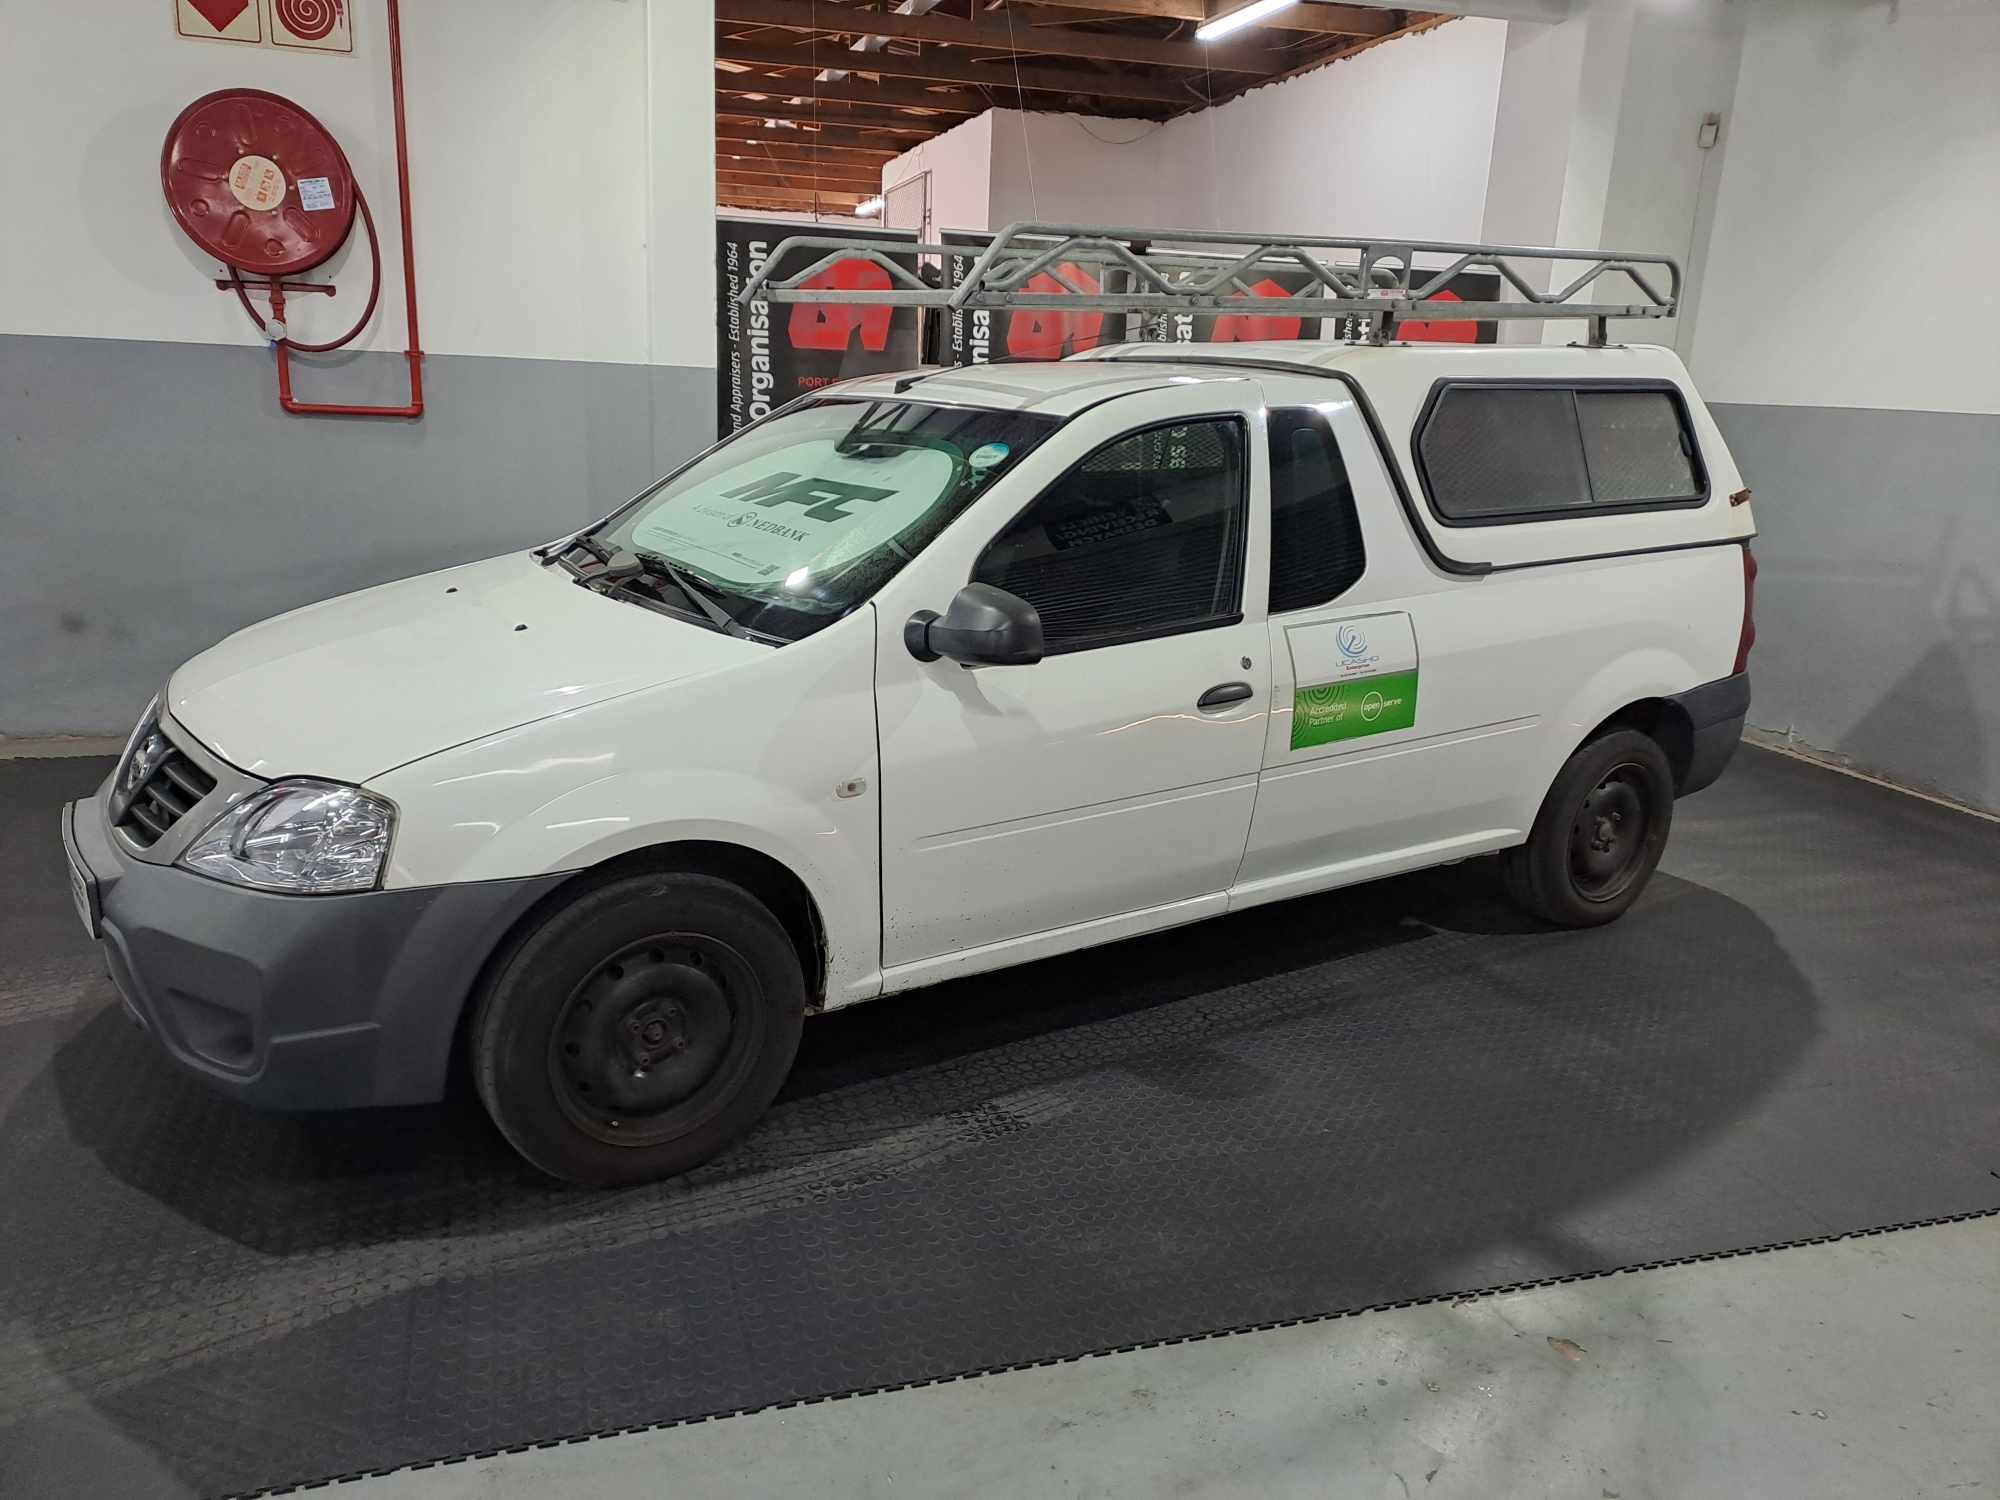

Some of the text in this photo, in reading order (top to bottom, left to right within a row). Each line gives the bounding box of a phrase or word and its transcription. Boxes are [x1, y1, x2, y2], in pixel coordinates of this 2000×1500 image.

[727, 242, 738, 271] 1964
[726, 273, 740, 341] Established
[729, 351, 743, 412] Appraisers
[750, 517, 811, 542] NEDBANK
[1335, 712, 1344, 721] of
